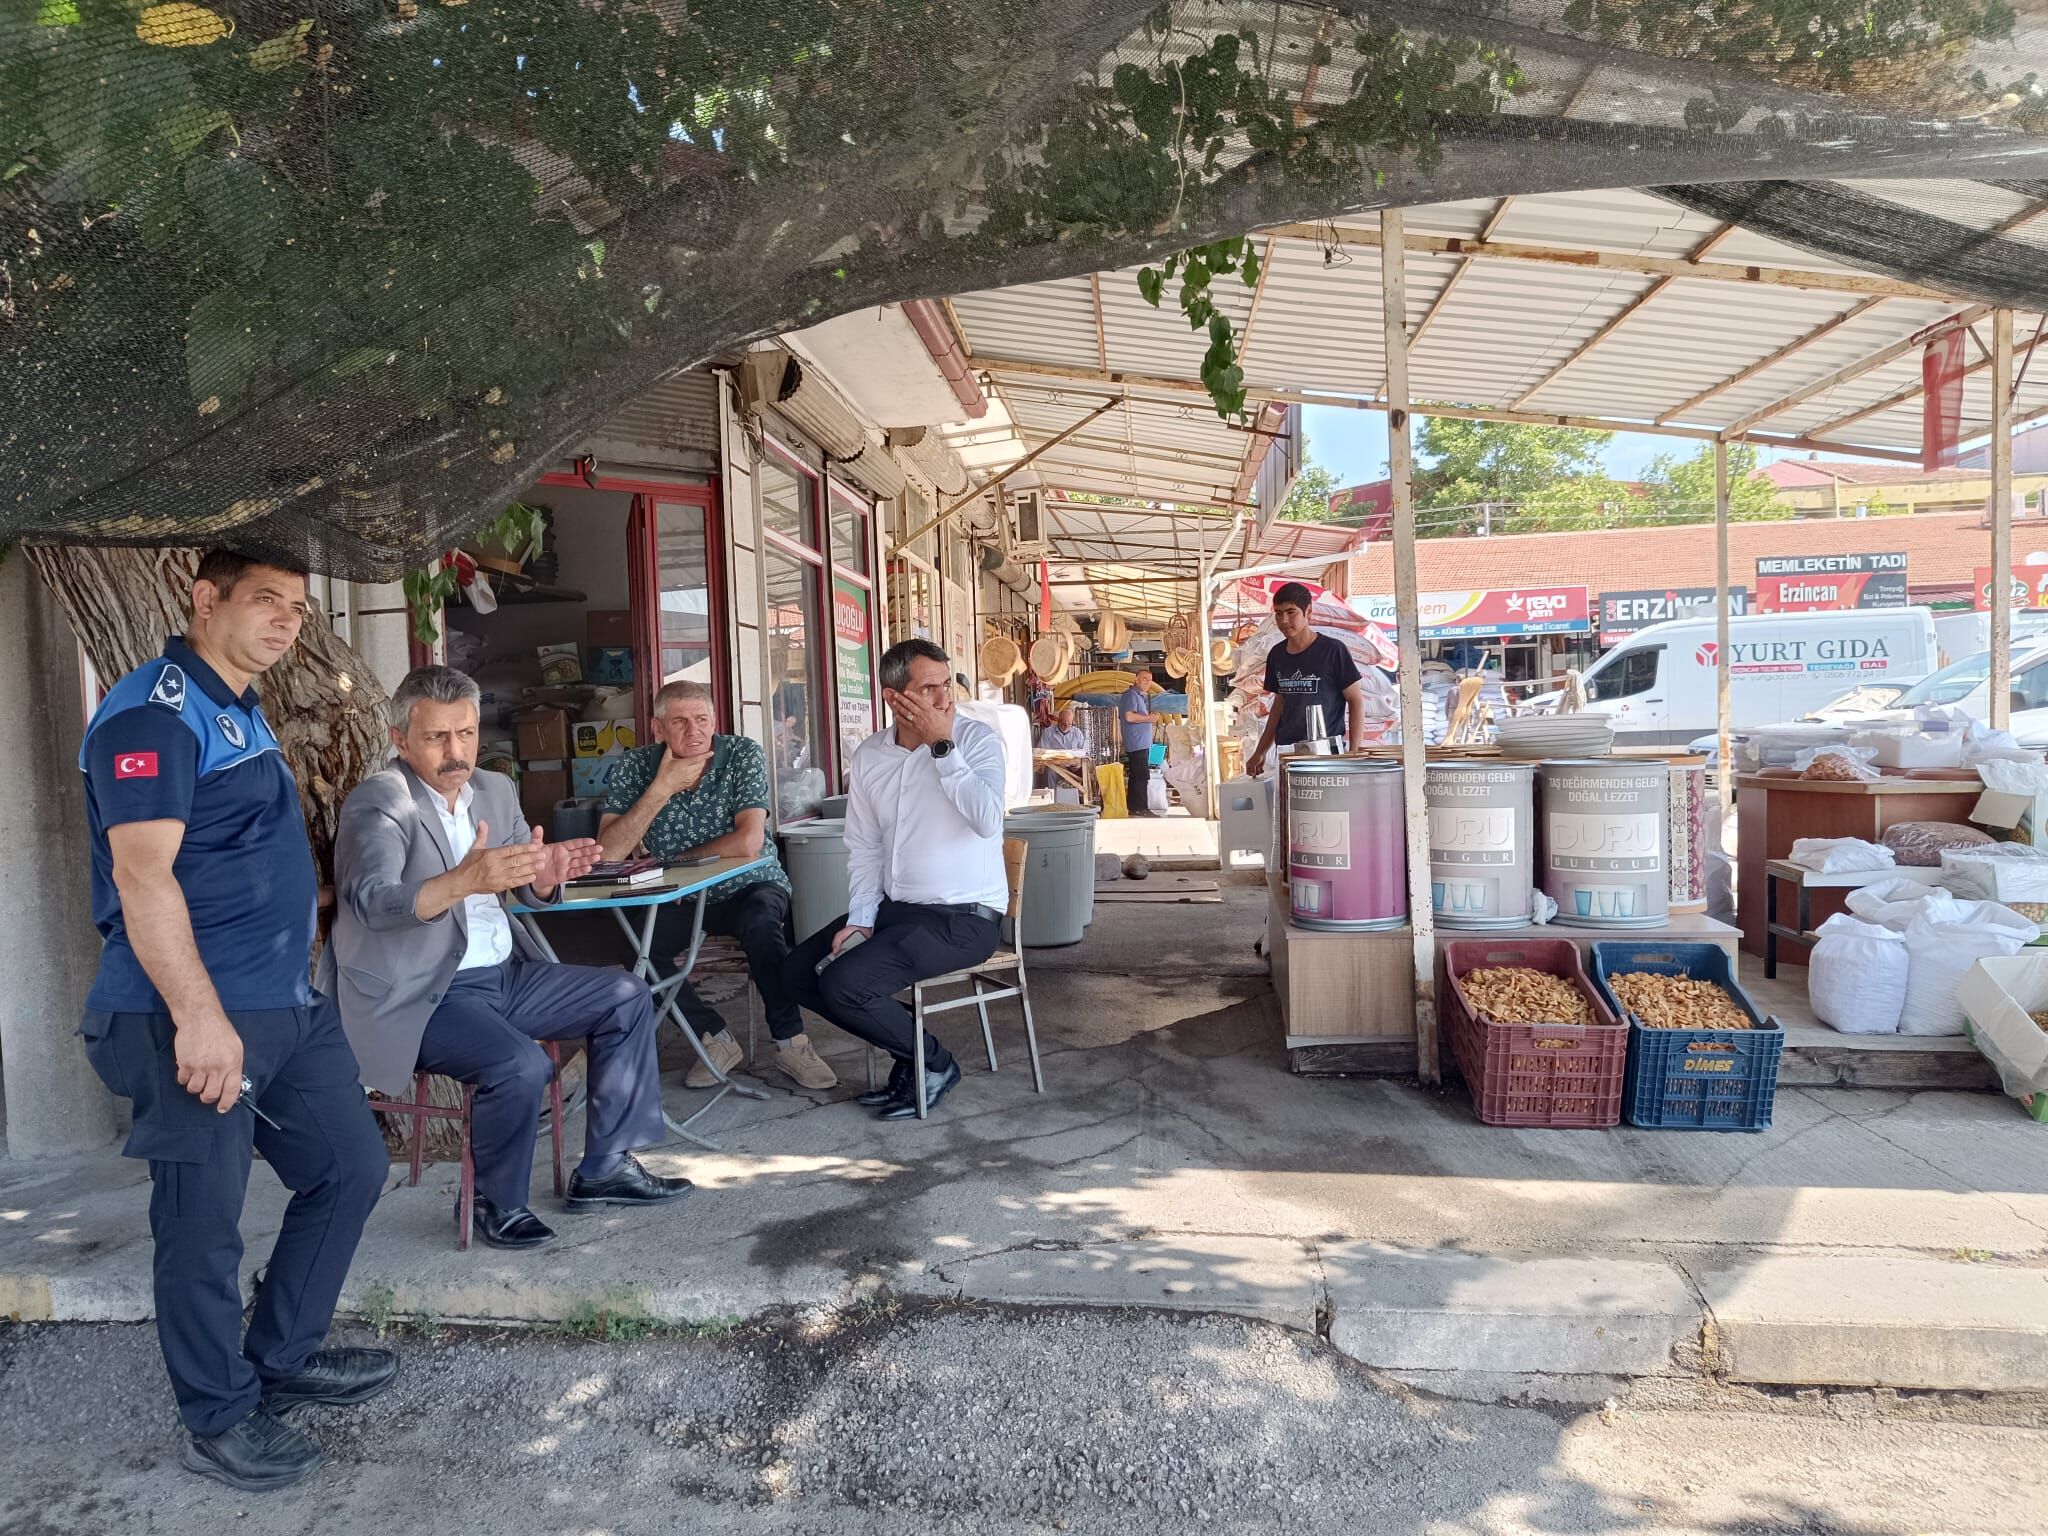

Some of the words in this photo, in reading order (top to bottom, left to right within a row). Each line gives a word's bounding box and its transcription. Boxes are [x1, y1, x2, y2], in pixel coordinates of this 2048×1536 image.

[1758, 554, 1862, 574] MEMLEKETİN
[1869, 554, 1906, 569] TADI
[1779, 582, 1838, 603] Erzincan
[1526, 595, 1567, 611] reva
[1527, 608, 1553, 620] yem
[1731, 641, 1807, 662] YURT
[1817, 638, 1890, 659] GIDA
[1862, 661, 1885, 669] BAL
[1319, 776, 1349, 787] GELEN
[1487, 772, 1515, 783] GELEN
[1562, 776, 1633, 789] DEĞİRMENDEN
[1427, 784, 1455, 796] DOĞAL
[1457, 786, 1491, 796] LEZZET
[1568, 789, 1602, 802] DOĞAL
[1604, 791, 1639, 802] LEZZET
[1552, 823, 1656, 852] DURU
[1683, 1057, 1735, 1072] DİMES
